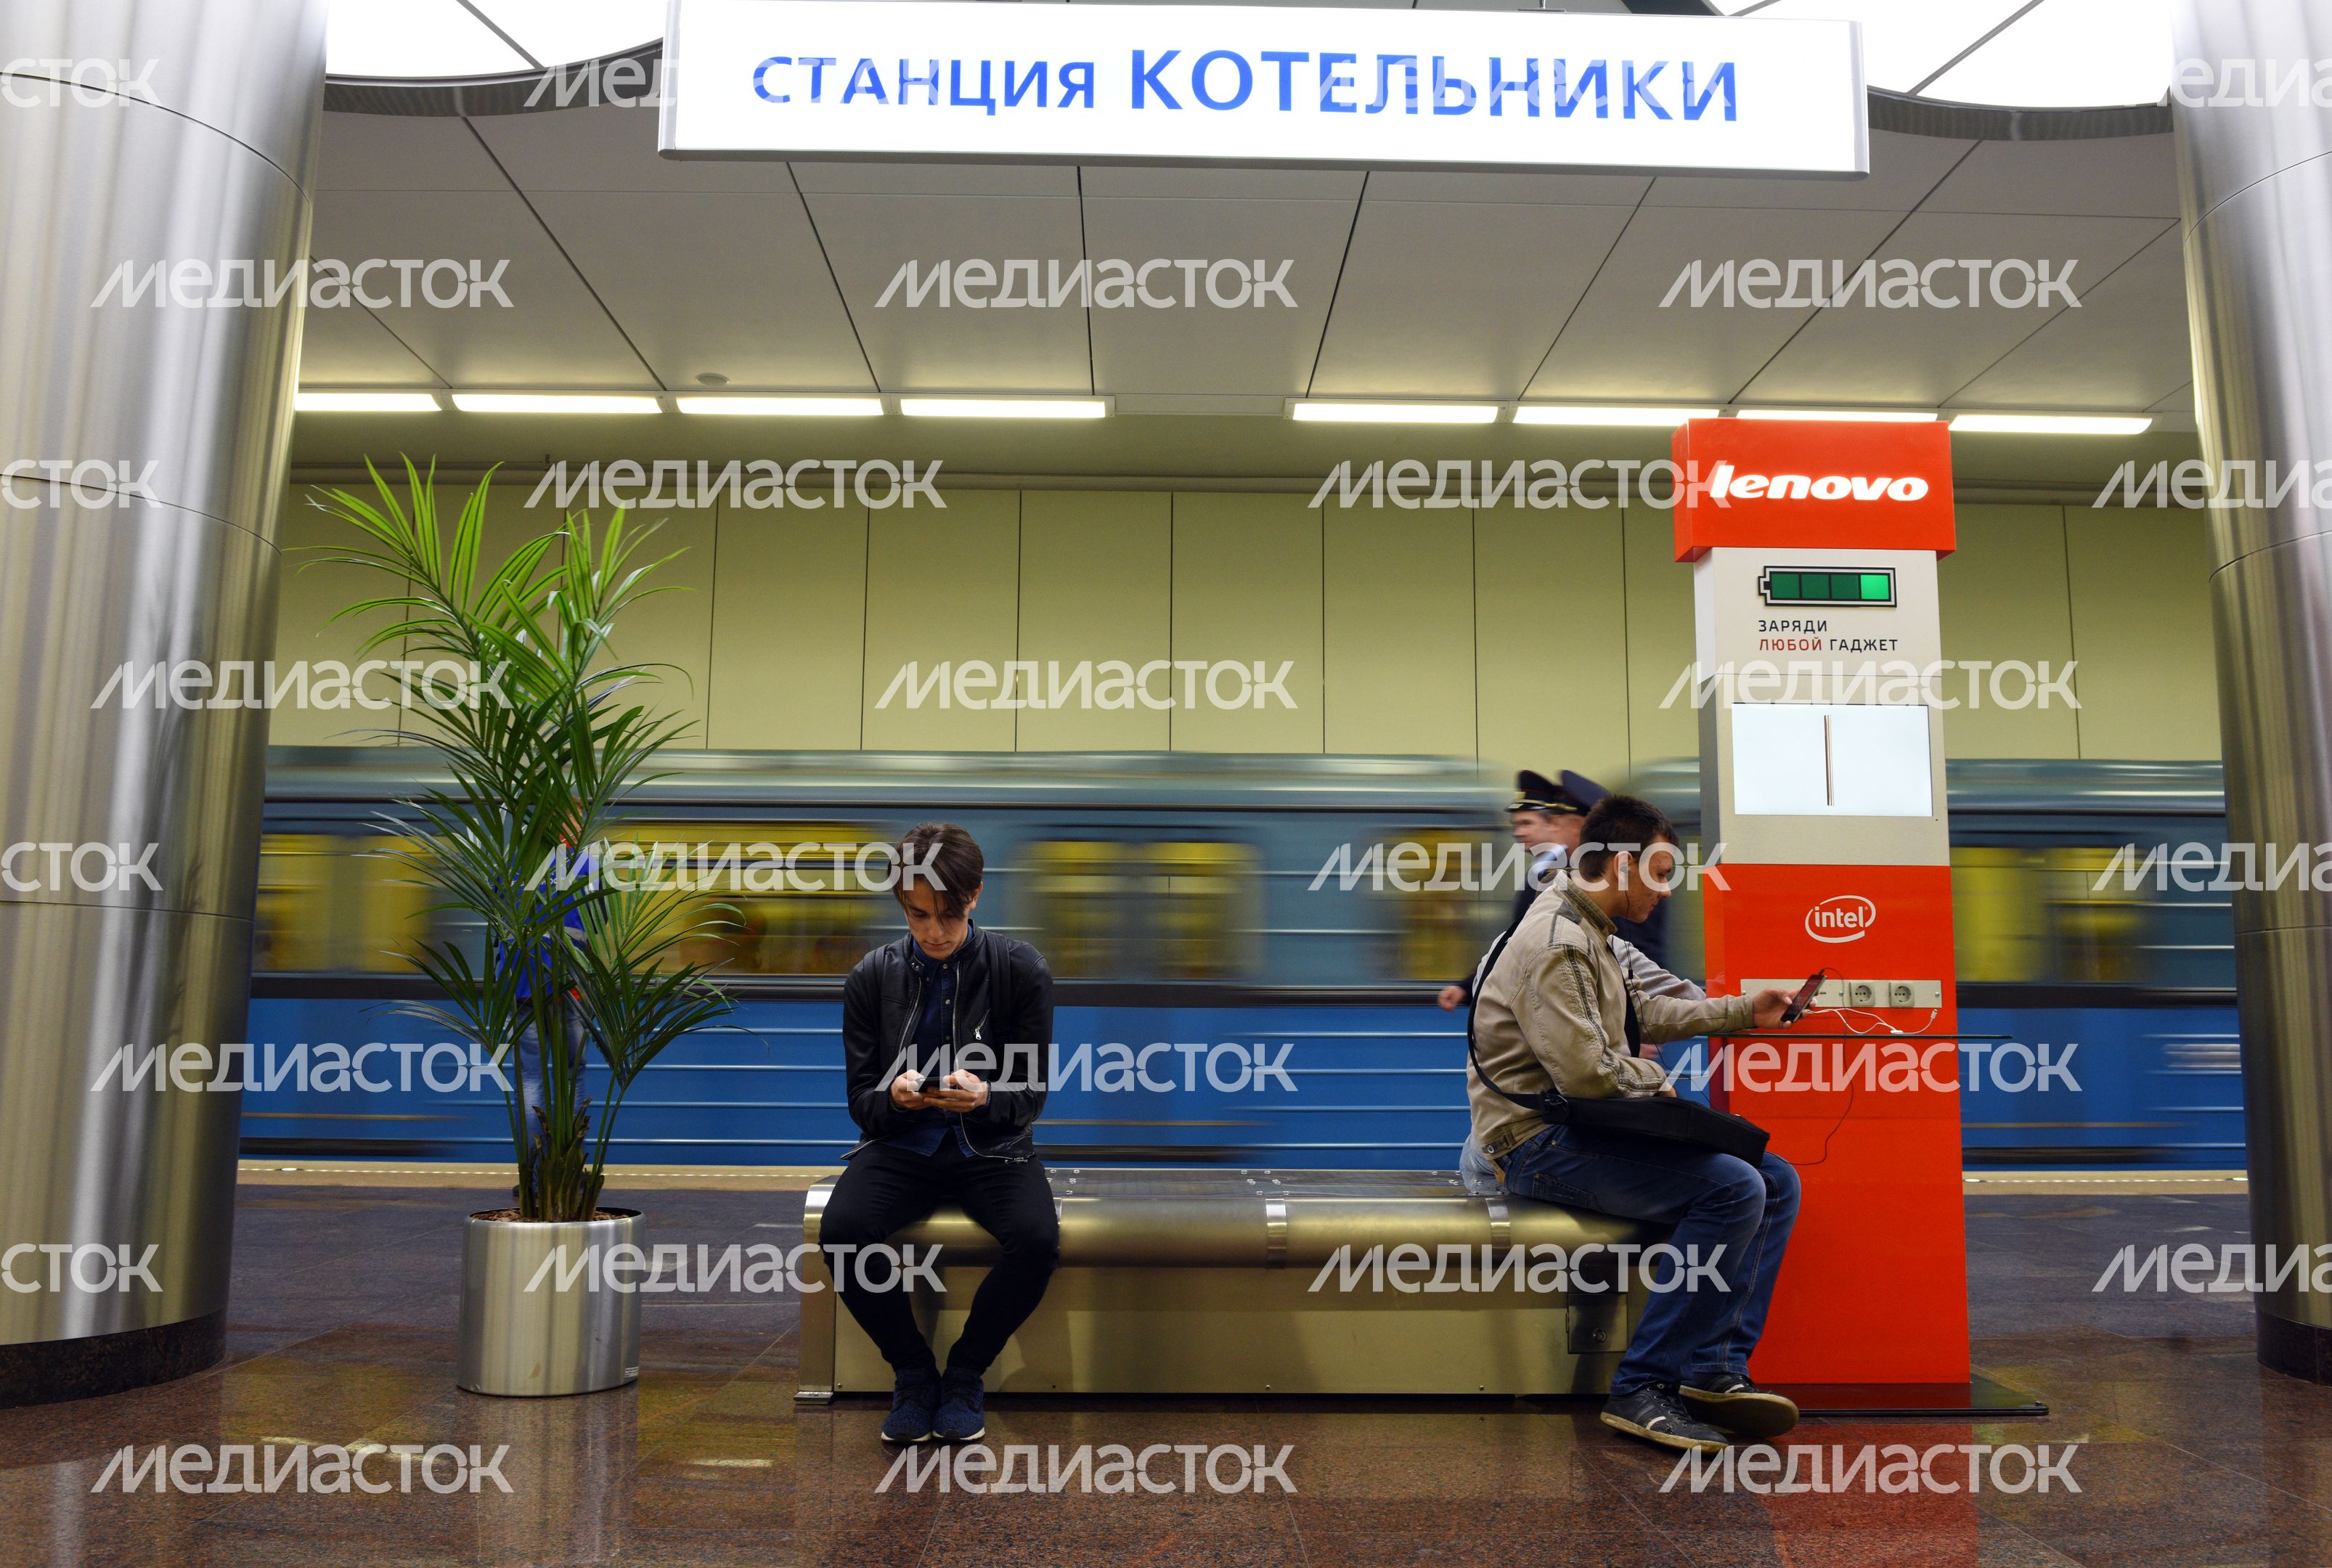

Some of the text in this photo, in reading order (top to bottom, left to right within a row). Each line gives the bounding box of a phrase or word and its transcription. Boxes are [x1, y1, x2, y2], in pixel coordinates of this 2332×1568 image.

[752, 56, 1095, 116] СТАНЦИЯ
[1131, 49, 1738, 122] КОТЕЛЬНИКИ
[1710, 465, 1928, 501] lenovo
[1758, 620, 1827, 634] ЗАРЯДИ
[1759, 637, 1899, 653] ЛЮБОЙ ГАДЖЕТ
[1814, 906, 1864, 928] intel
